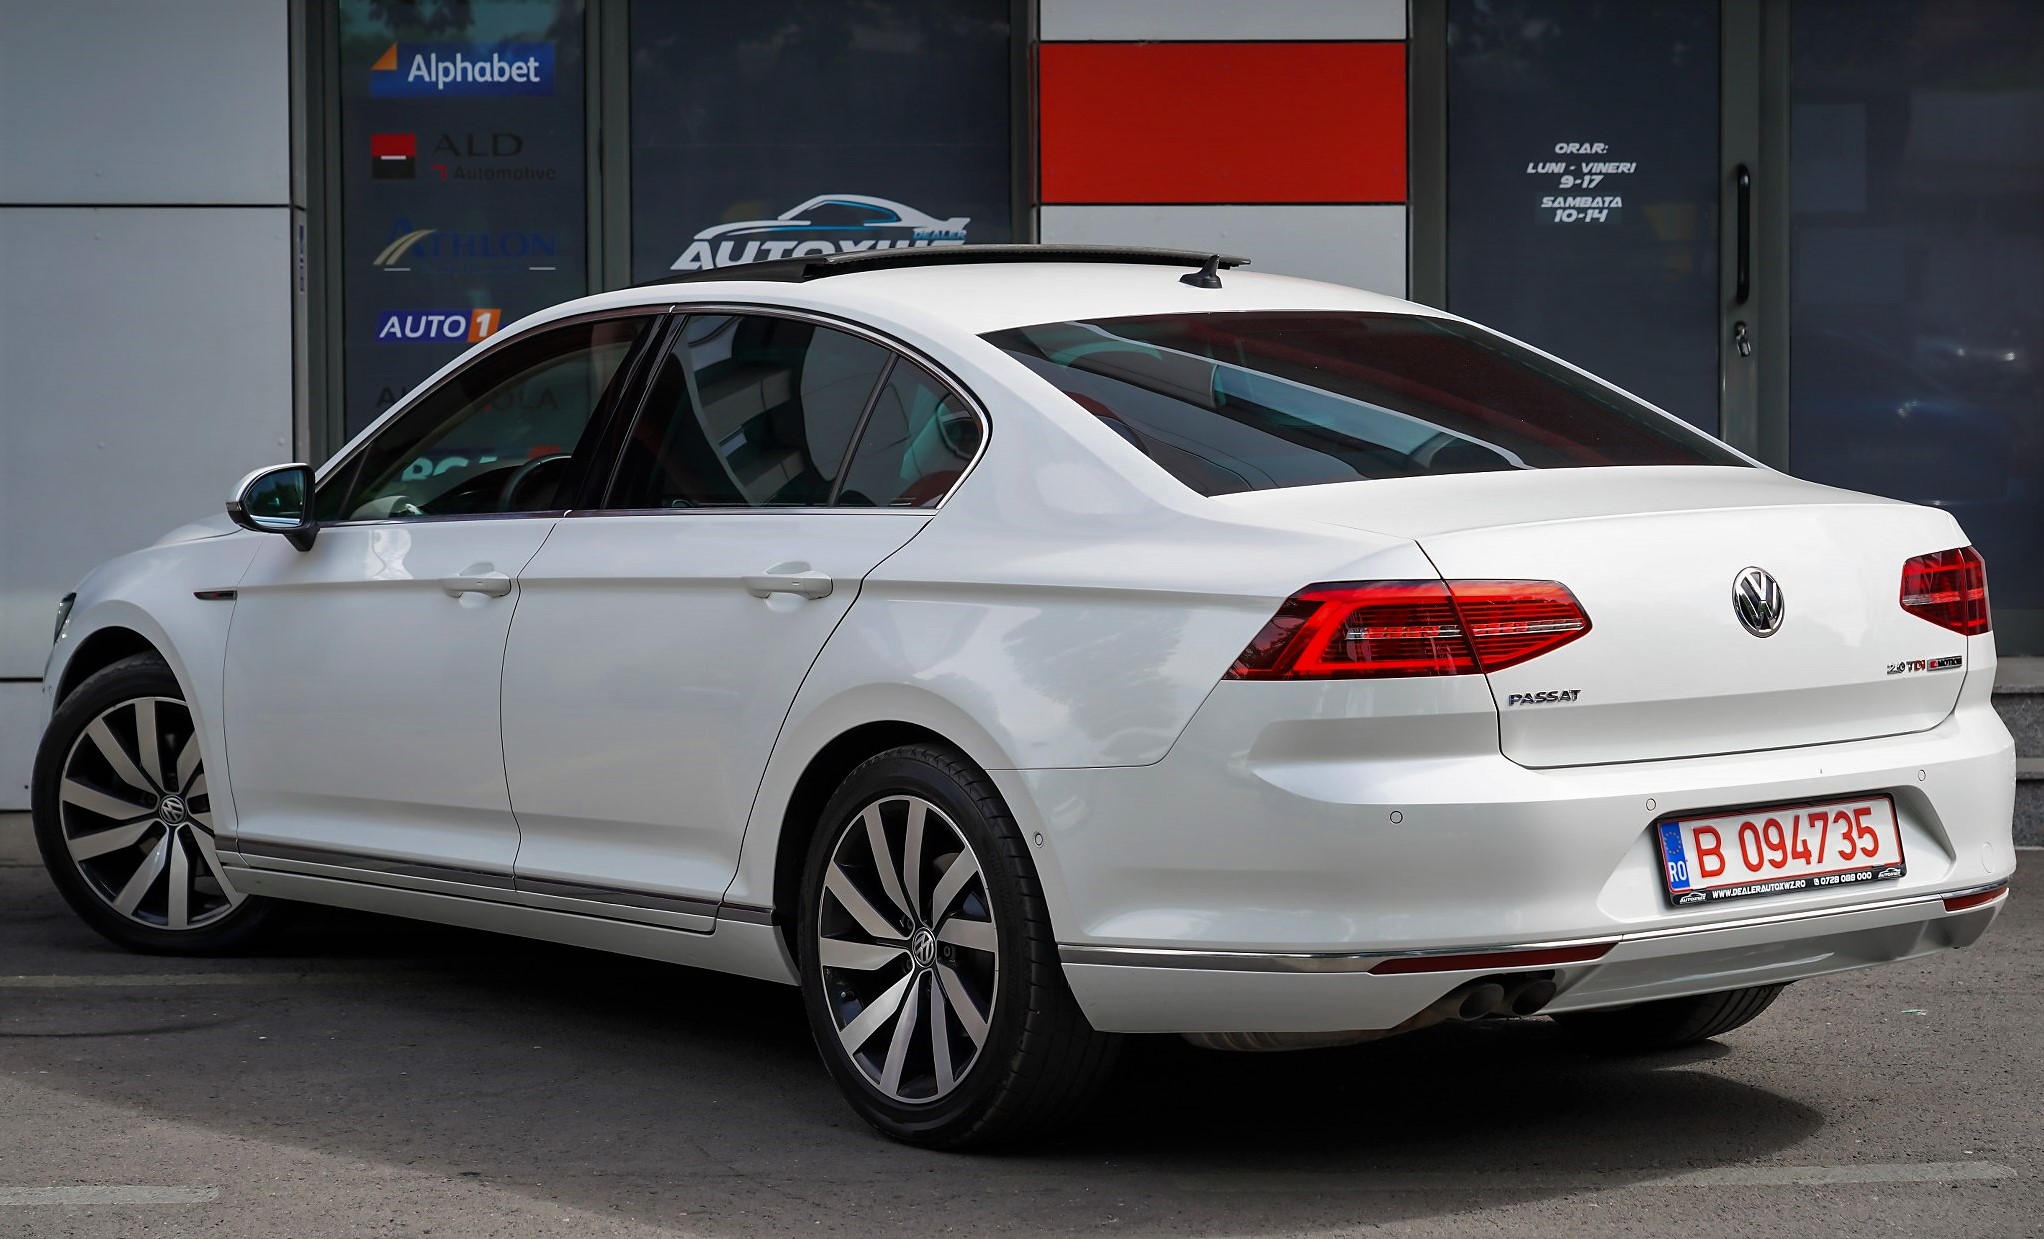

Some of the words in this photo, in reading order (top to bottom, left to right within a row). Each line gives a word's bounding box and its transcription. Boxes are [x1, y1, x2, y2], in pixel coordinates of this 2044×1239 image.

[407, 53, 541, 89] Alphabet
[431, 133, 524, 157] ALD
[1554, 142, 1609, 154] ORAR:
[453, 165, 557, 182] Automotive
[1526, 162, 1566, 174] LUNI
[1581, 162, 1637, 174] VINERI
[1559, 175, 1604, 189] 9-17
[1541, 196, 1623, 208] SAMBATA
[1554, 209, 1609, 223] 10-14
[912, 229, 967, 240] DEALER
[1906, 660, 1926, 673] TDI
[1508, 689, 1581, 706] PASSAT
[1669, 860, 1688, 883] RO
[1692, 825, 1726, 878] B
[1738, 806, 1880, 873] 094735
[1712, 879, 1806, 899] WWW.DEALERAUTOXWZ.RO
[1857, 871, 1872, 880] 000
